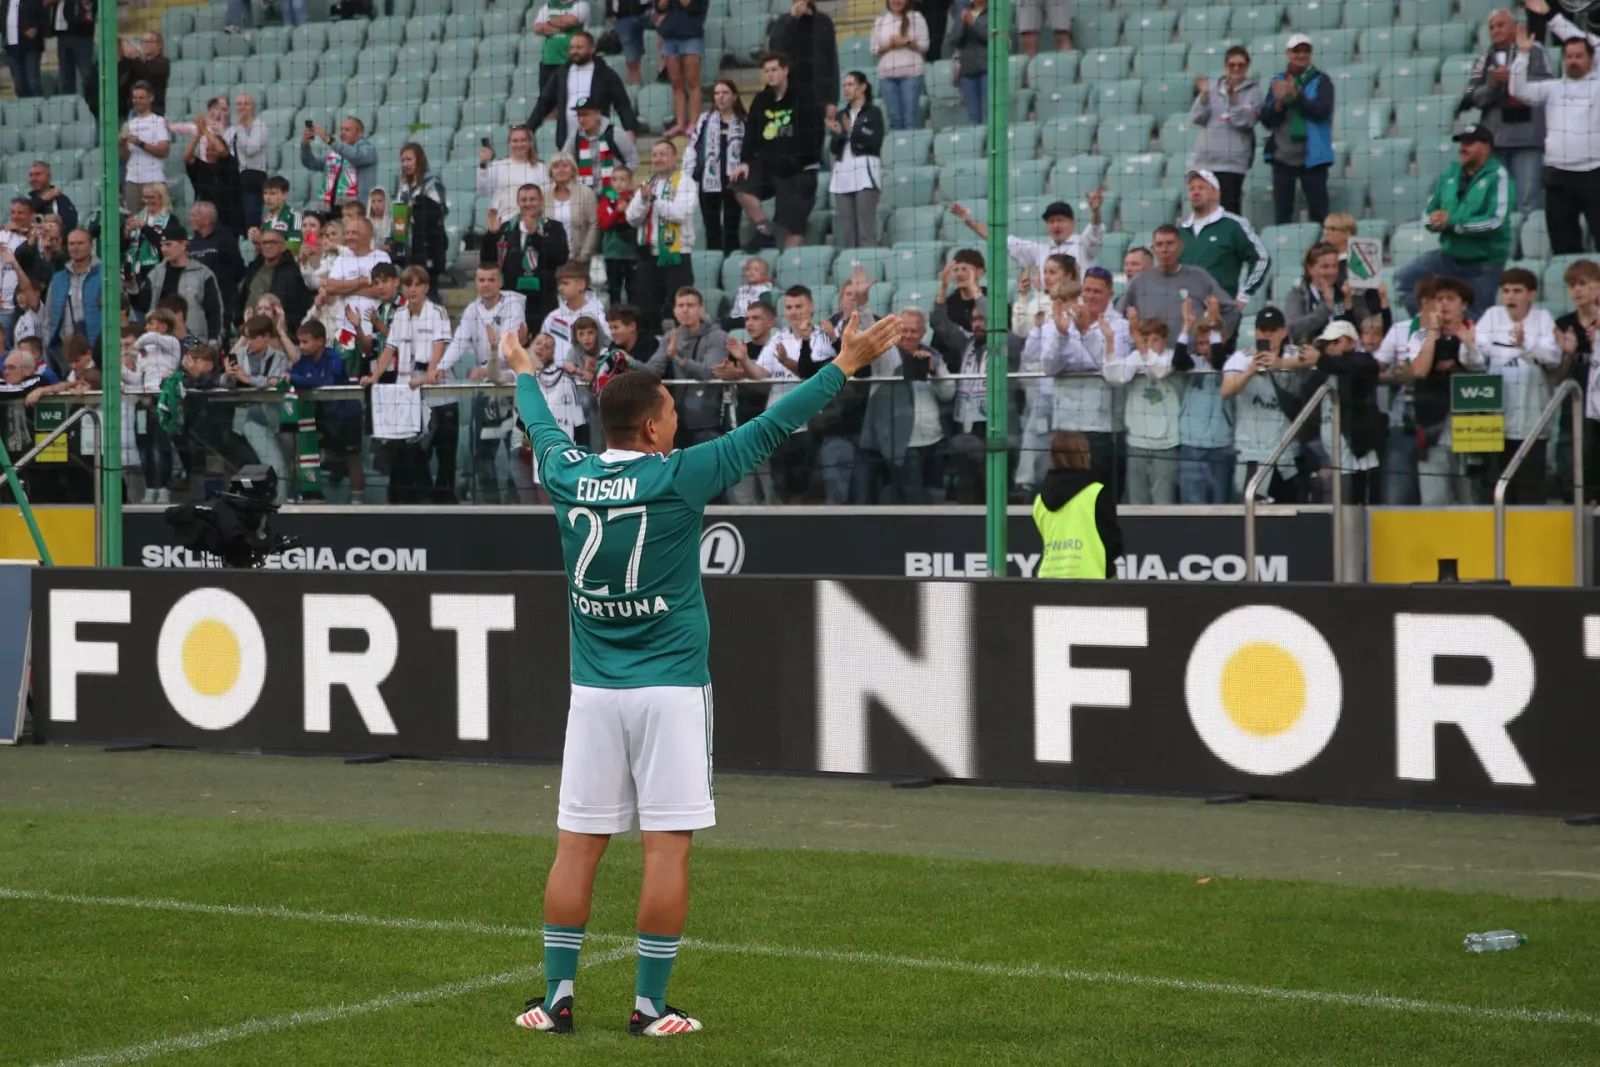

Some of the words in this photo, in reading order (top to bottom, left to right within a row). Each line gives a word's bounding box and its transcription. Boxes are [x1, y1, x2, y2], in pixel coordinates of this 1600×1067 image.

[1460, 386, 1495, 398] W-3
[41, 411, 62, 420] W-2
[577, 476, 637, 501] EDSON
[567, 504, 647, 596] 27
[571, 591, 669, 618] FORTUNA
[1033, 604, 1600, 786] FOR
